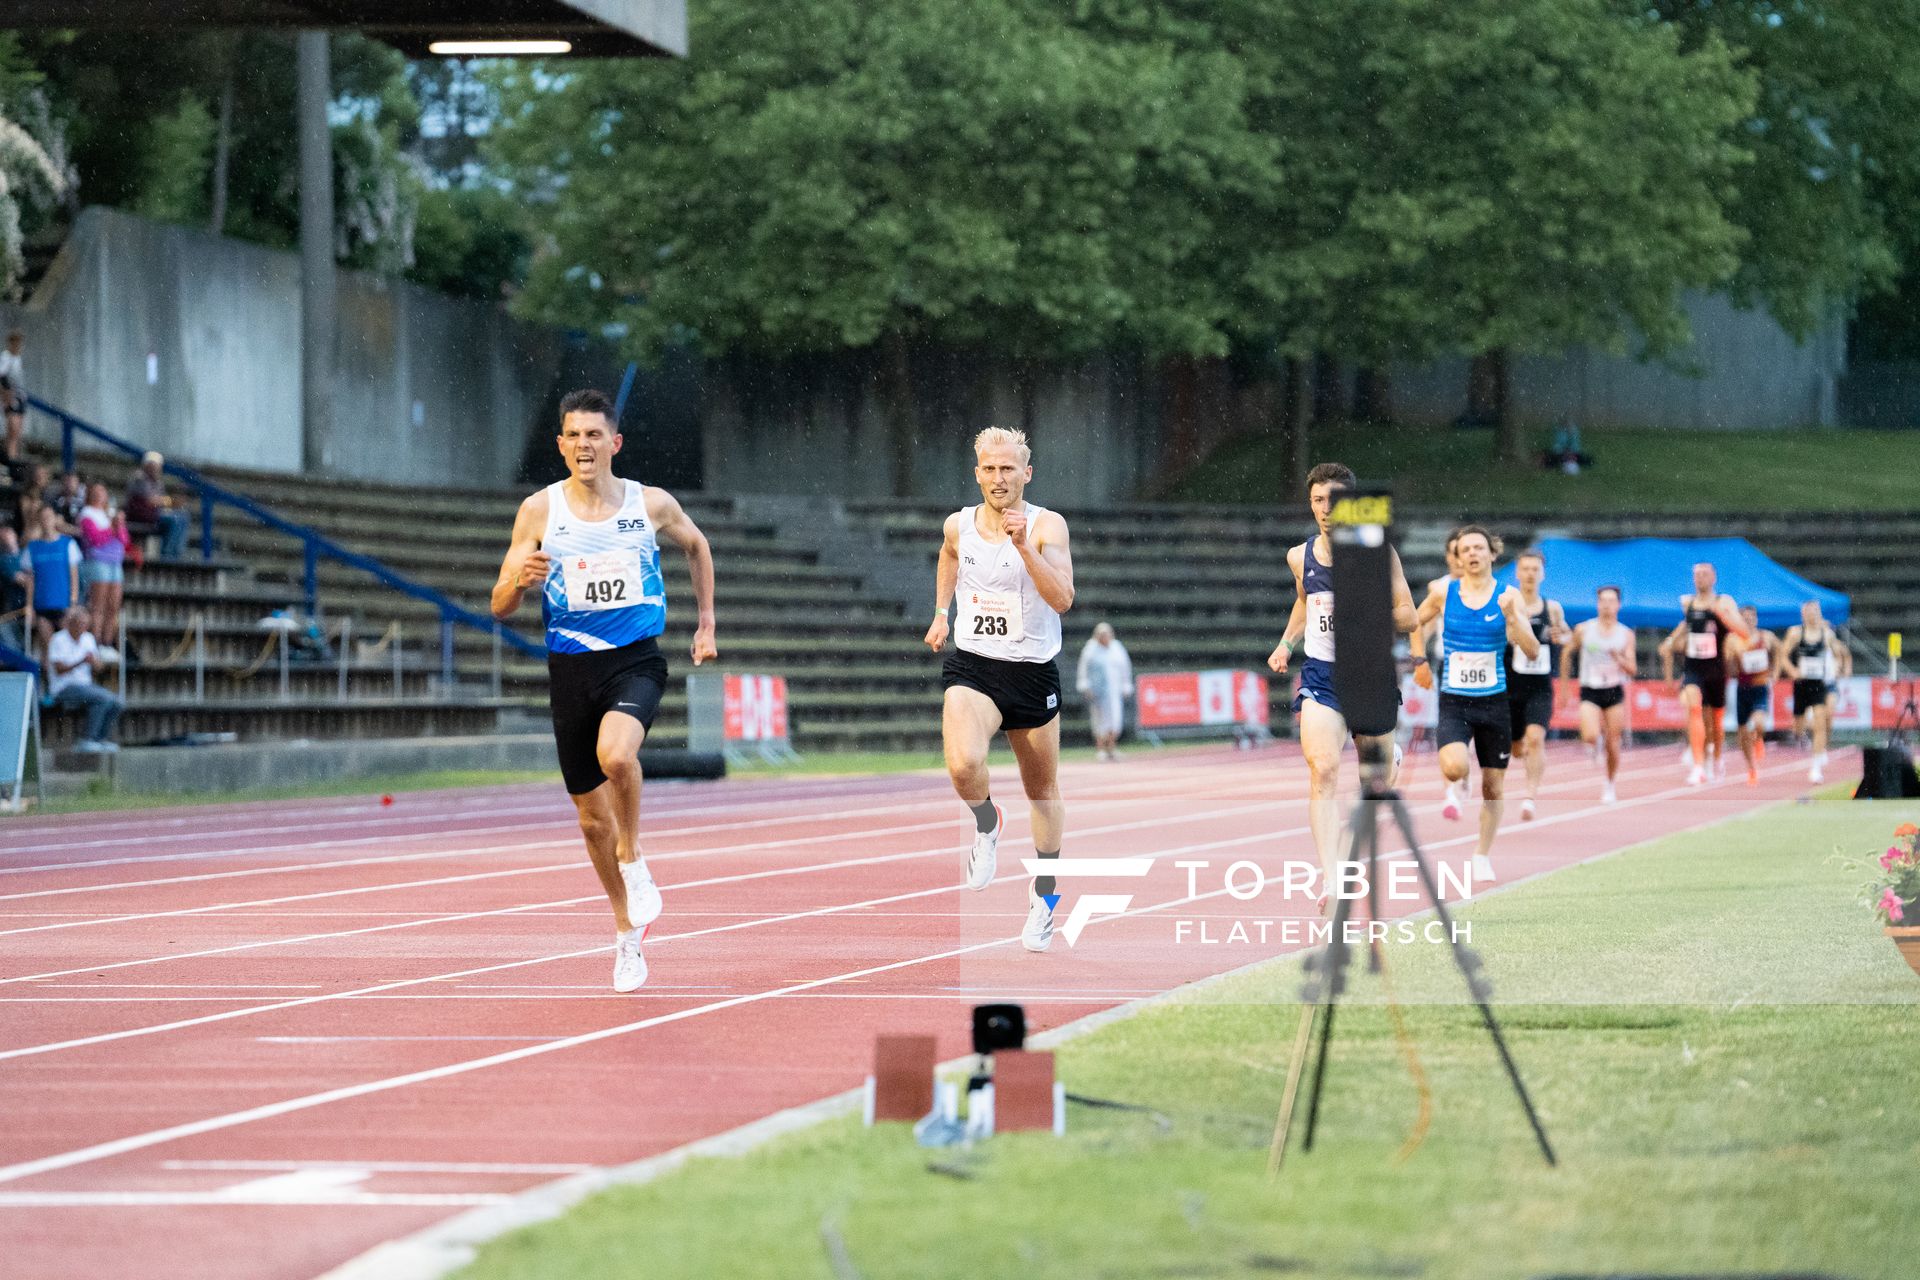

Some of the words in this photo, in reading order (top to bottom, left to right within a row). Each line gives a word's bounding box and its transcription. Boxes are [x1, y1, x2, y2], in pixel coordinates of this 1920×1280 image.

[617, 519, 645, 530] SVS
[964, 556, 976, 566] TVL
[585, 578, 627, 604] 492
[973, 615, 1008, 636] 233
[1319, 615, 1335, 633] 58
[1460, 668, 1487, 684] 596
